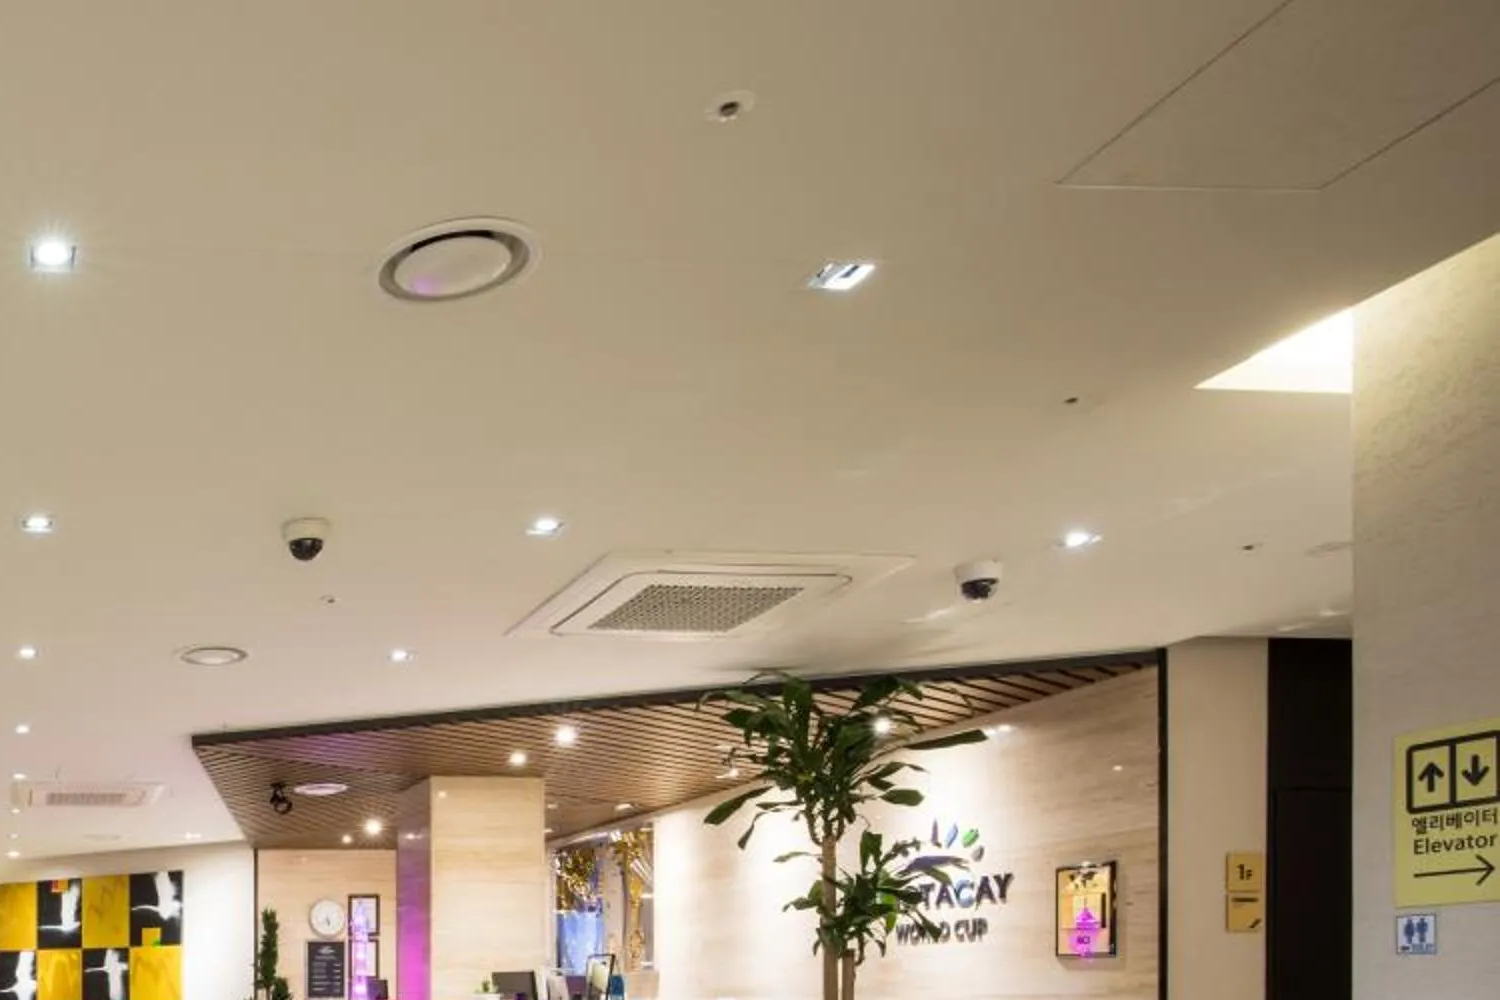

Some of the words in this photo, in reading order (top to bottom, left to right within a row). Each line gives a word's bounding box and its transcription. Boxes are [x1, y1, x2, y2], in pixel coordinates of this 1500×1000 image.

[1412, 807, 1498, 835] 엘리베이터
[1413, 833, 1498, 855] Elevator
[906, 872, 1014, 911] TACAY
[896, 920, 951, 946] WOD
[954, 917, 989, 944] CUP
